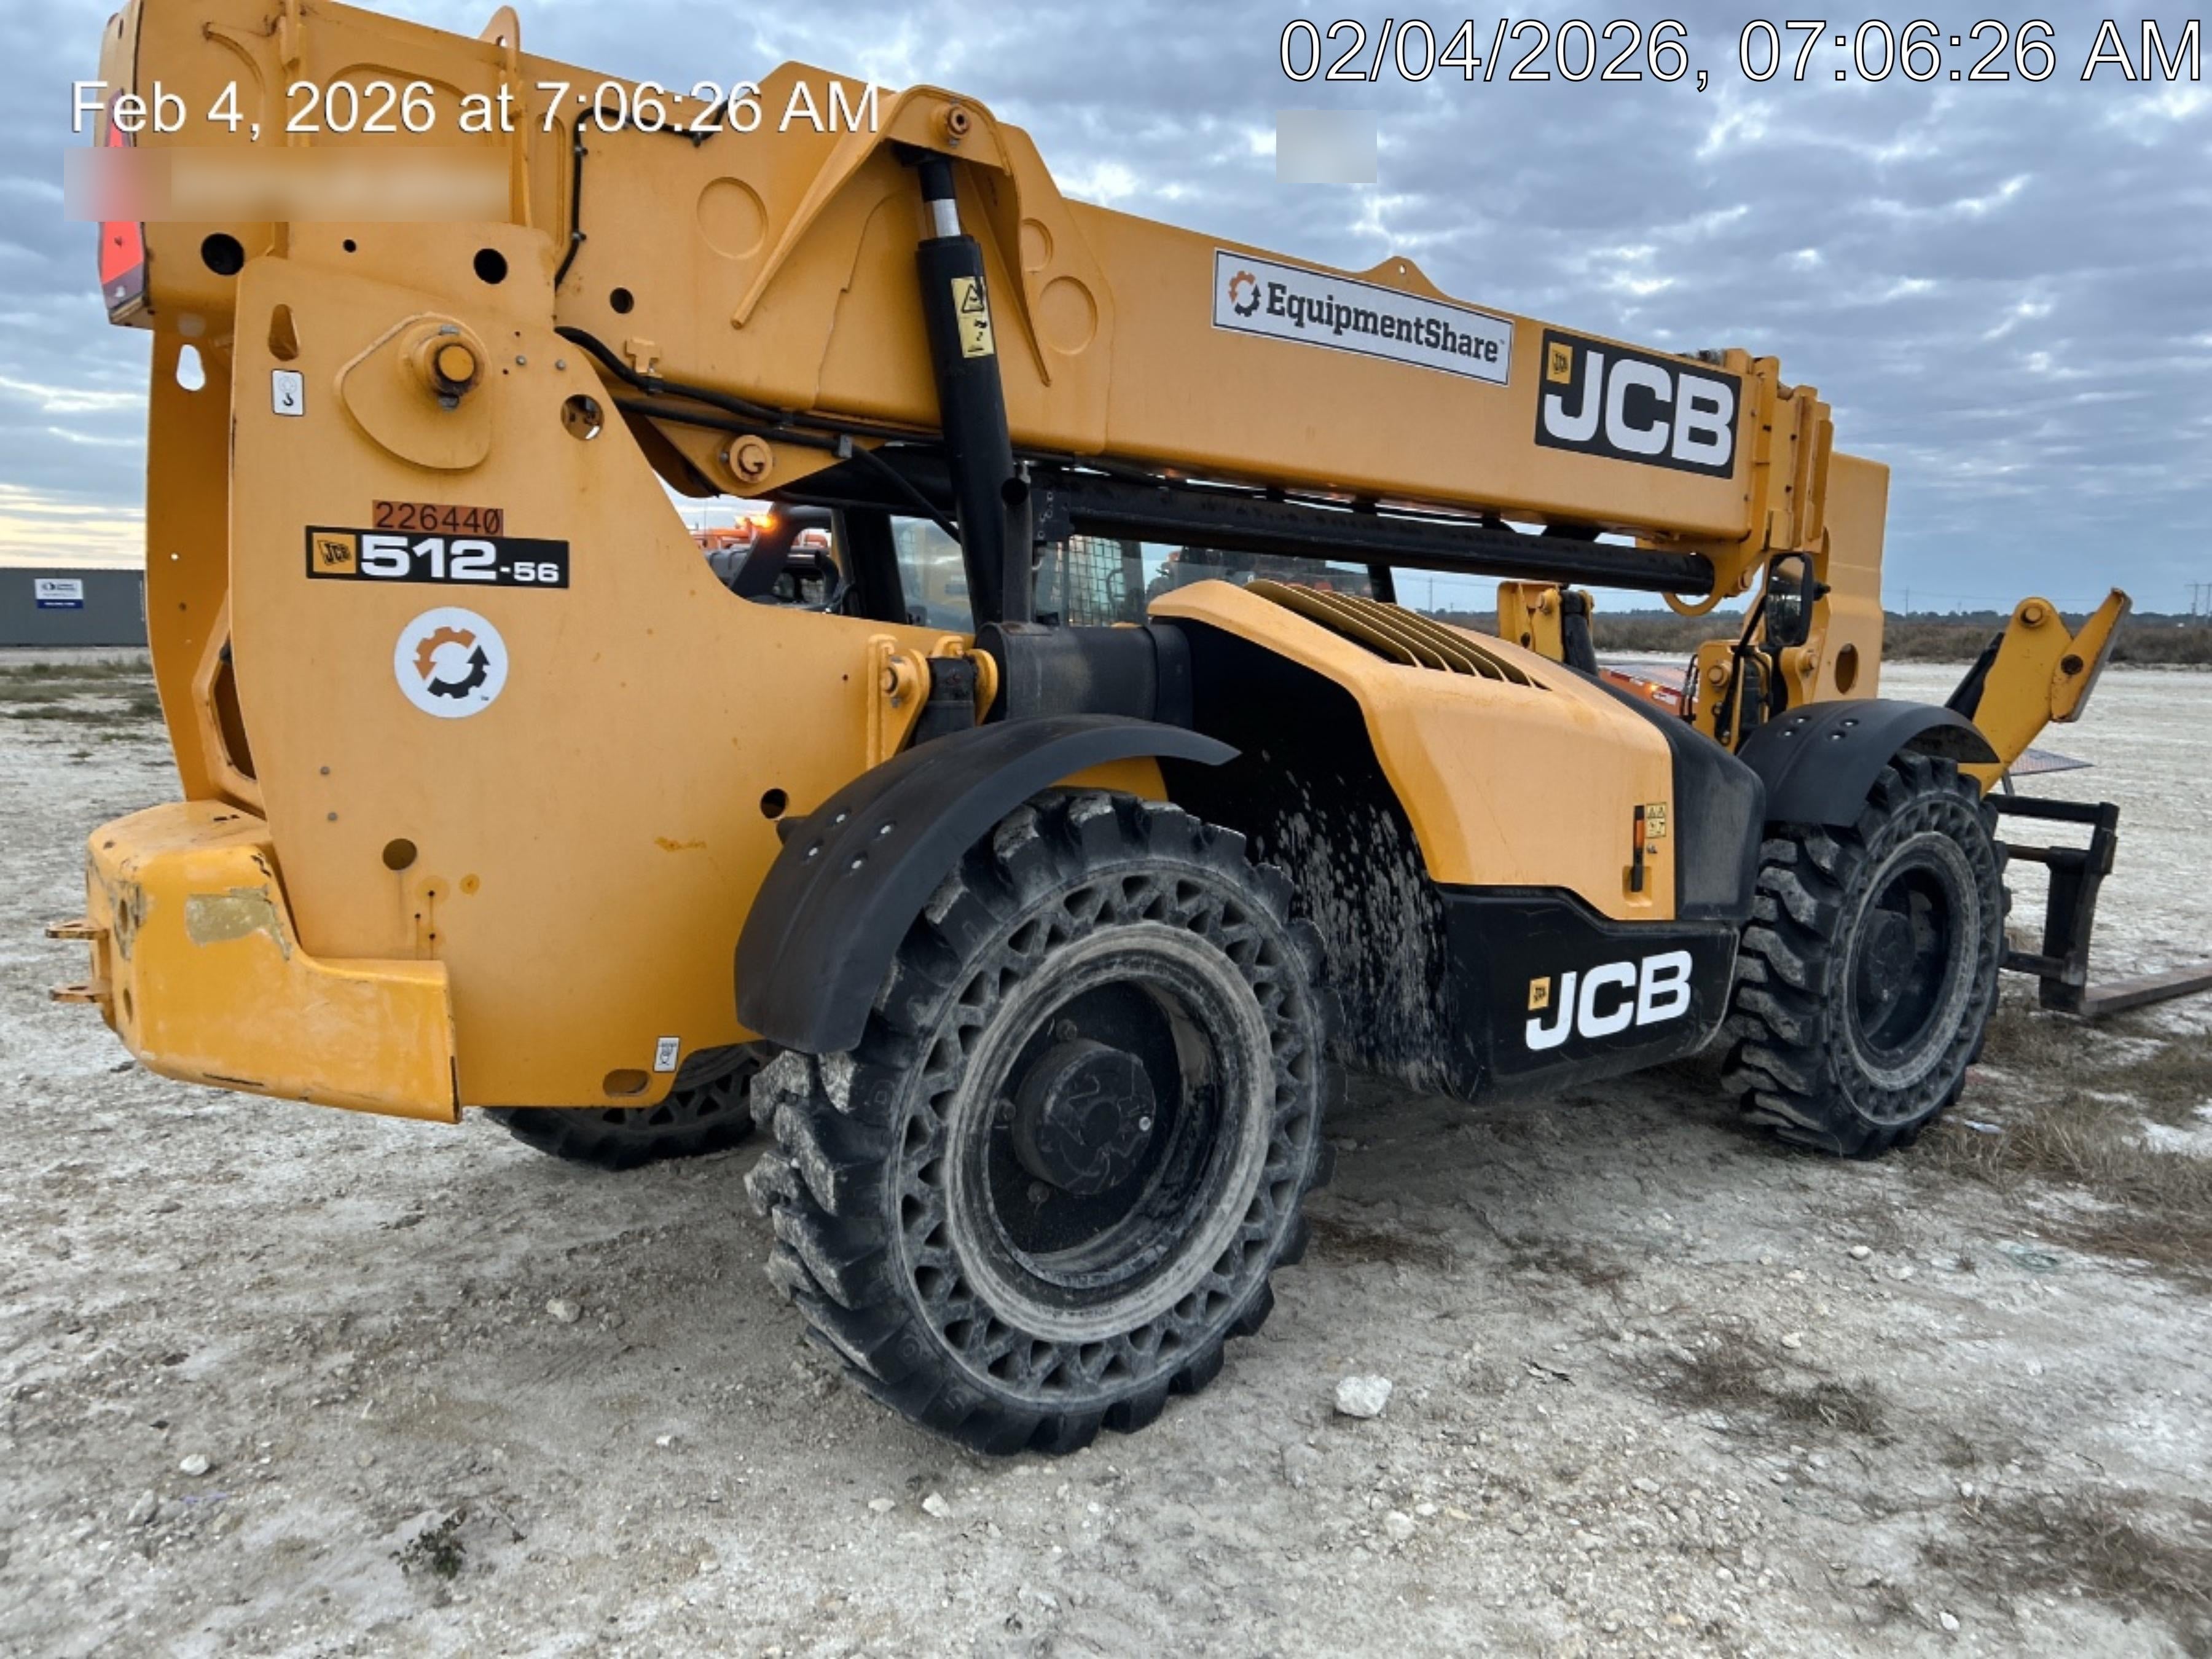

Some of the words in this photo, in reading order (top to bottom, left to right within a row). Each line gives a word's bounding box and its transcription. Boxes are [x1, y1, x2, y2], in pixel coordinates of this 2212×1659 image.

[1266, 281, 1498, 363] EquipmentShare
[1544, 349, 1734, 467] JCB
[360, 533, 560, 583] 512-56
[376, 501, 502, 535] 226440
[1526, 949, 1693, 1051] JCB
